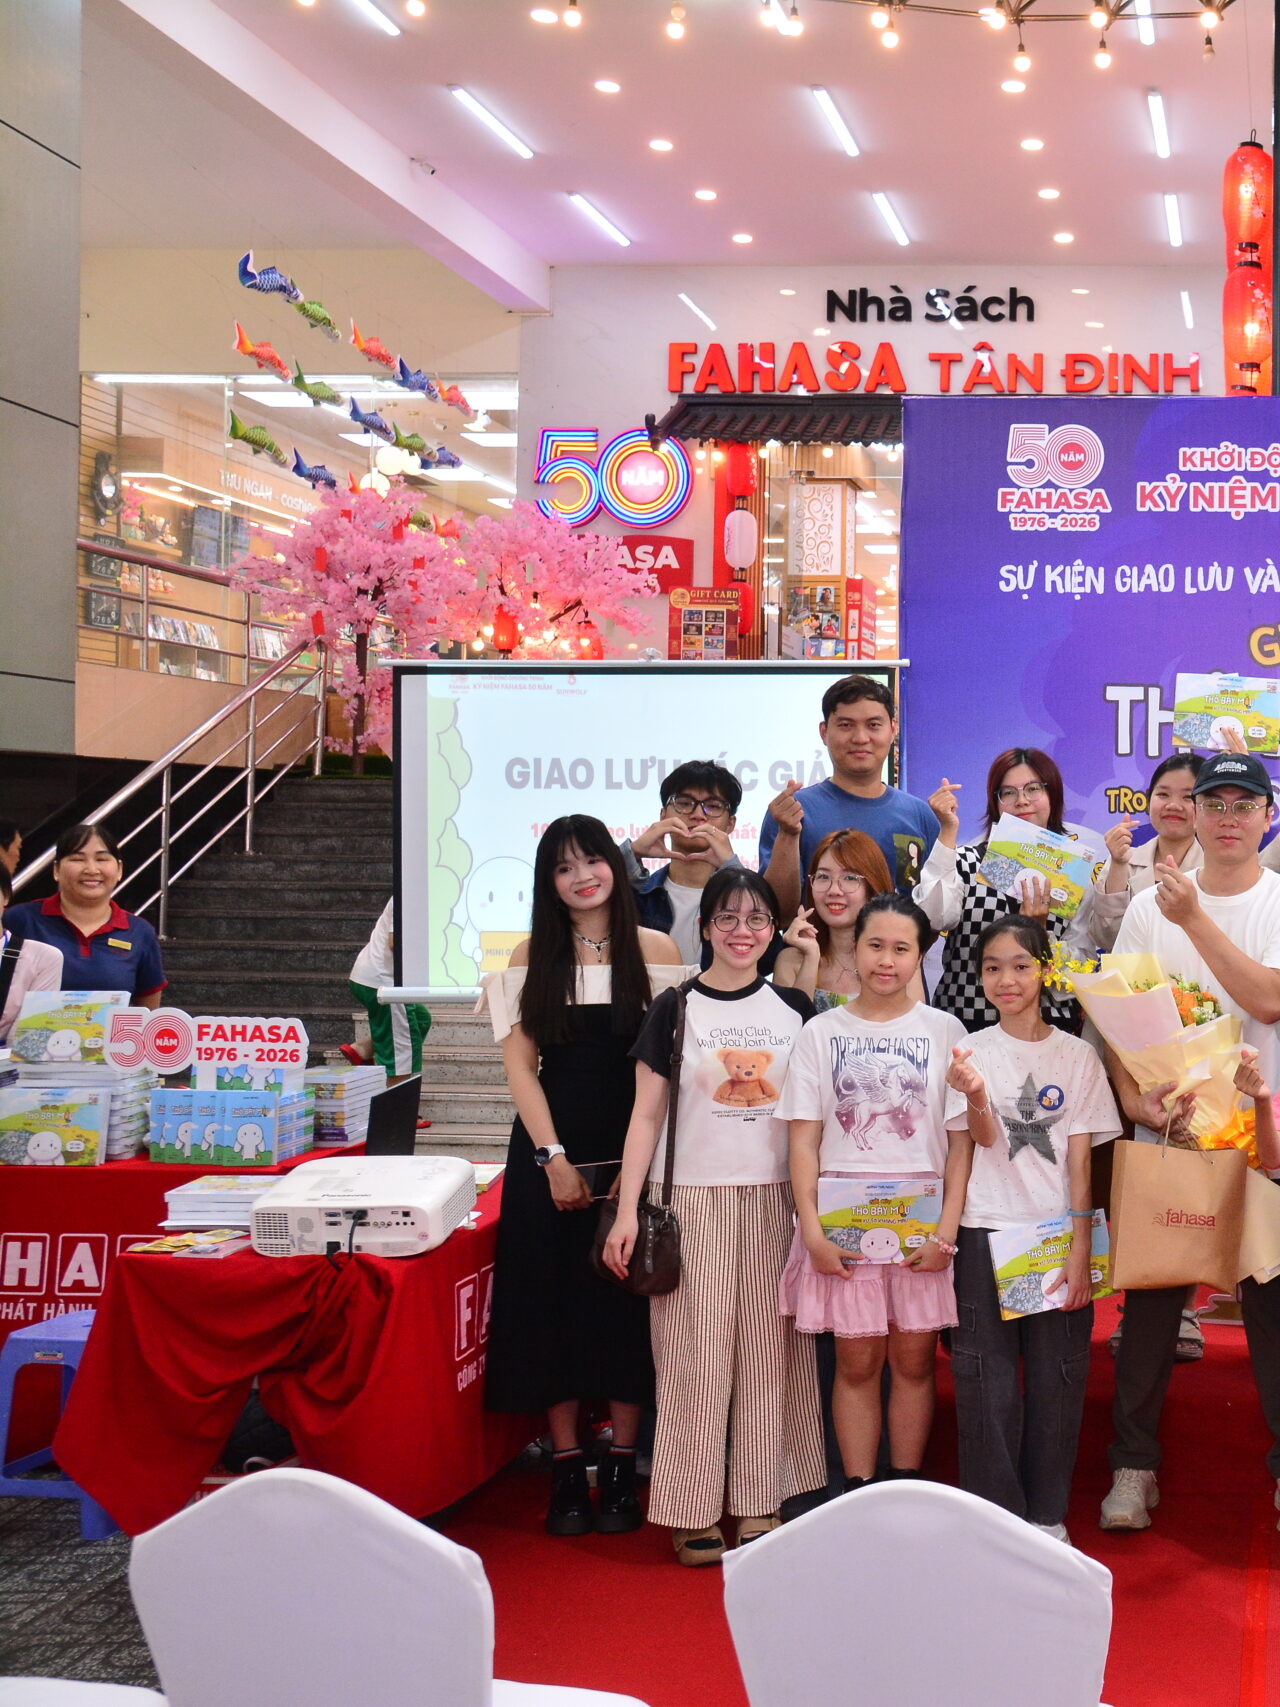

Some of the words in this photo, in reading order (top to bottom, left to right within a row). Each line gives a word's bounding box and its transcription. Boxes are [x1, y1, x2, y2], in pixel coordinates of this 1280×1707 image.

[826, 285, 912, 323] Nhà
[924, 286, 1035, 323] Sách
[667, 342, 907, 393] FAHASA
[928, 342, 1045, 393] TÂN
[1006, 424, 1105, 488] 50
[1060, 450, 1084, 463] NĂM
[1181, 443, 1244, 471] KHỞI
[534, 427, 693, 528] 50
[621, 464, 666, 488] NĂM
[999, 489, 1110, 512] FAHASA
[1138, 474, 1186, 511] KỶ
[1191, 478, 1278, 519] NIỆM
[1012, 516, 1047, 529] 1976
[1060, 516, 1097, 529] 2026
[587, 545, 680, 569] ASA
[998, 560, 1037, 600] SỰ
[1045, 559, 1105, 600] KIỆN
[1114, 563, 1175, 593] GIAO
[1184, 561, 1234, 595] LƯU
[1244, 558, 1280, 596] VÀ
[690, 590, 712, 600] GIFT
[714, 590, 739, 600] CARD
[1104, 684, 1192, 757] TH
[505, 756, 595, 790] GIAO
[1105, 787, 1148, 813] TRO
[110, 1014, 193, 1068] 50
[156, 1034, 178, 1047] NĂM
[196, 1023, 301, 1044] FAHASA
[696, 1037, 716, 1049] Will
[719, 1037, 741, 1049] You
[742, 1037, 766, 1049] Join
[769, 1035, 791, 1046] Us?
[745, 1025, 771, 1037] Club
[196, 1047, 238, 1062] 1976
[255, 1047, 301, 1063] 2026
[851, 1203, 869, 1216] THỎ
[1165, 1208, 1216, 1228] fahasa
[1026, 1248, 1043, 1260] THỎ
[0, 1297, 38, 1321] HÁT
[457, 1360, 478, 1393] CÔNG
